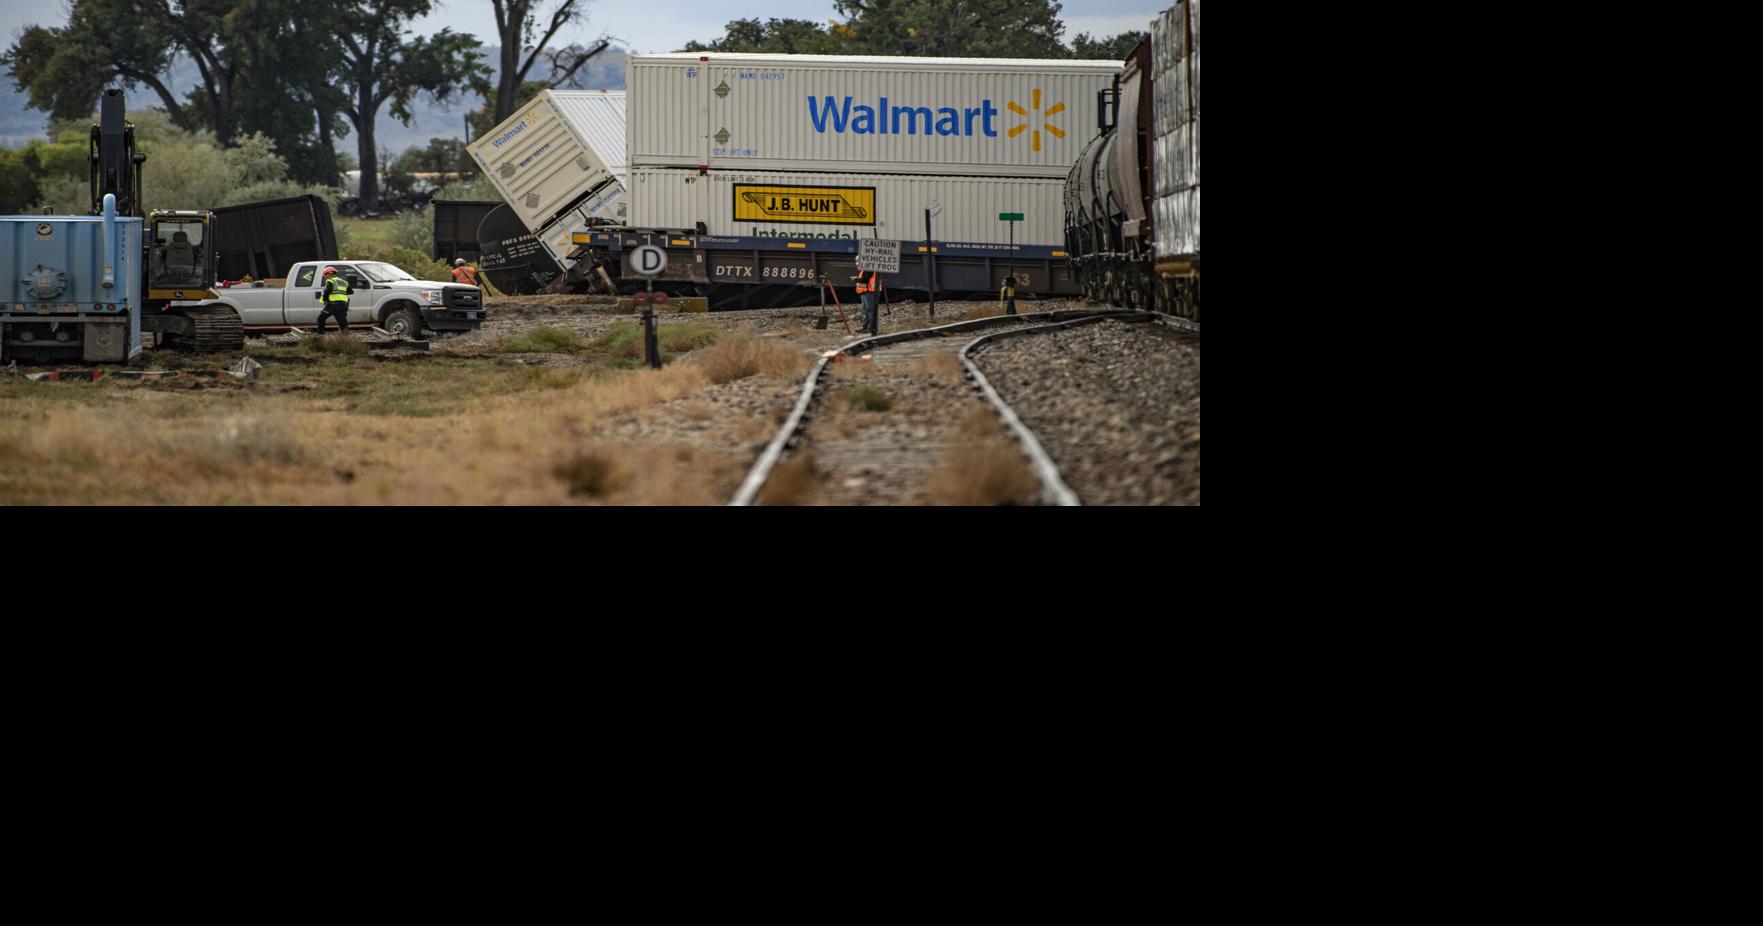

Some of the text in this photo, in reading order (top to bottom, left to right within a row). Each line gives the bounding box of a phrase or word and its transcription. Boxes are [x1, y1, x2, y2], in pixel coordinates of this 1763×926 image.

[807, 95, 998, 137] Walmart
[491, 120, 528, 148] Walmart
[767, 197, 841, 213] J.B. HUNT
[864, 240, 897, 249] CAUTION
[865, 247, 894, 256] HY-RAIL
[642, 249, 662, 271] D
[861, 255, 898, 264] VEHICLES
[715, 265, 816, 279] DTTX 888896
[877, 263, 897, 271] FROG
